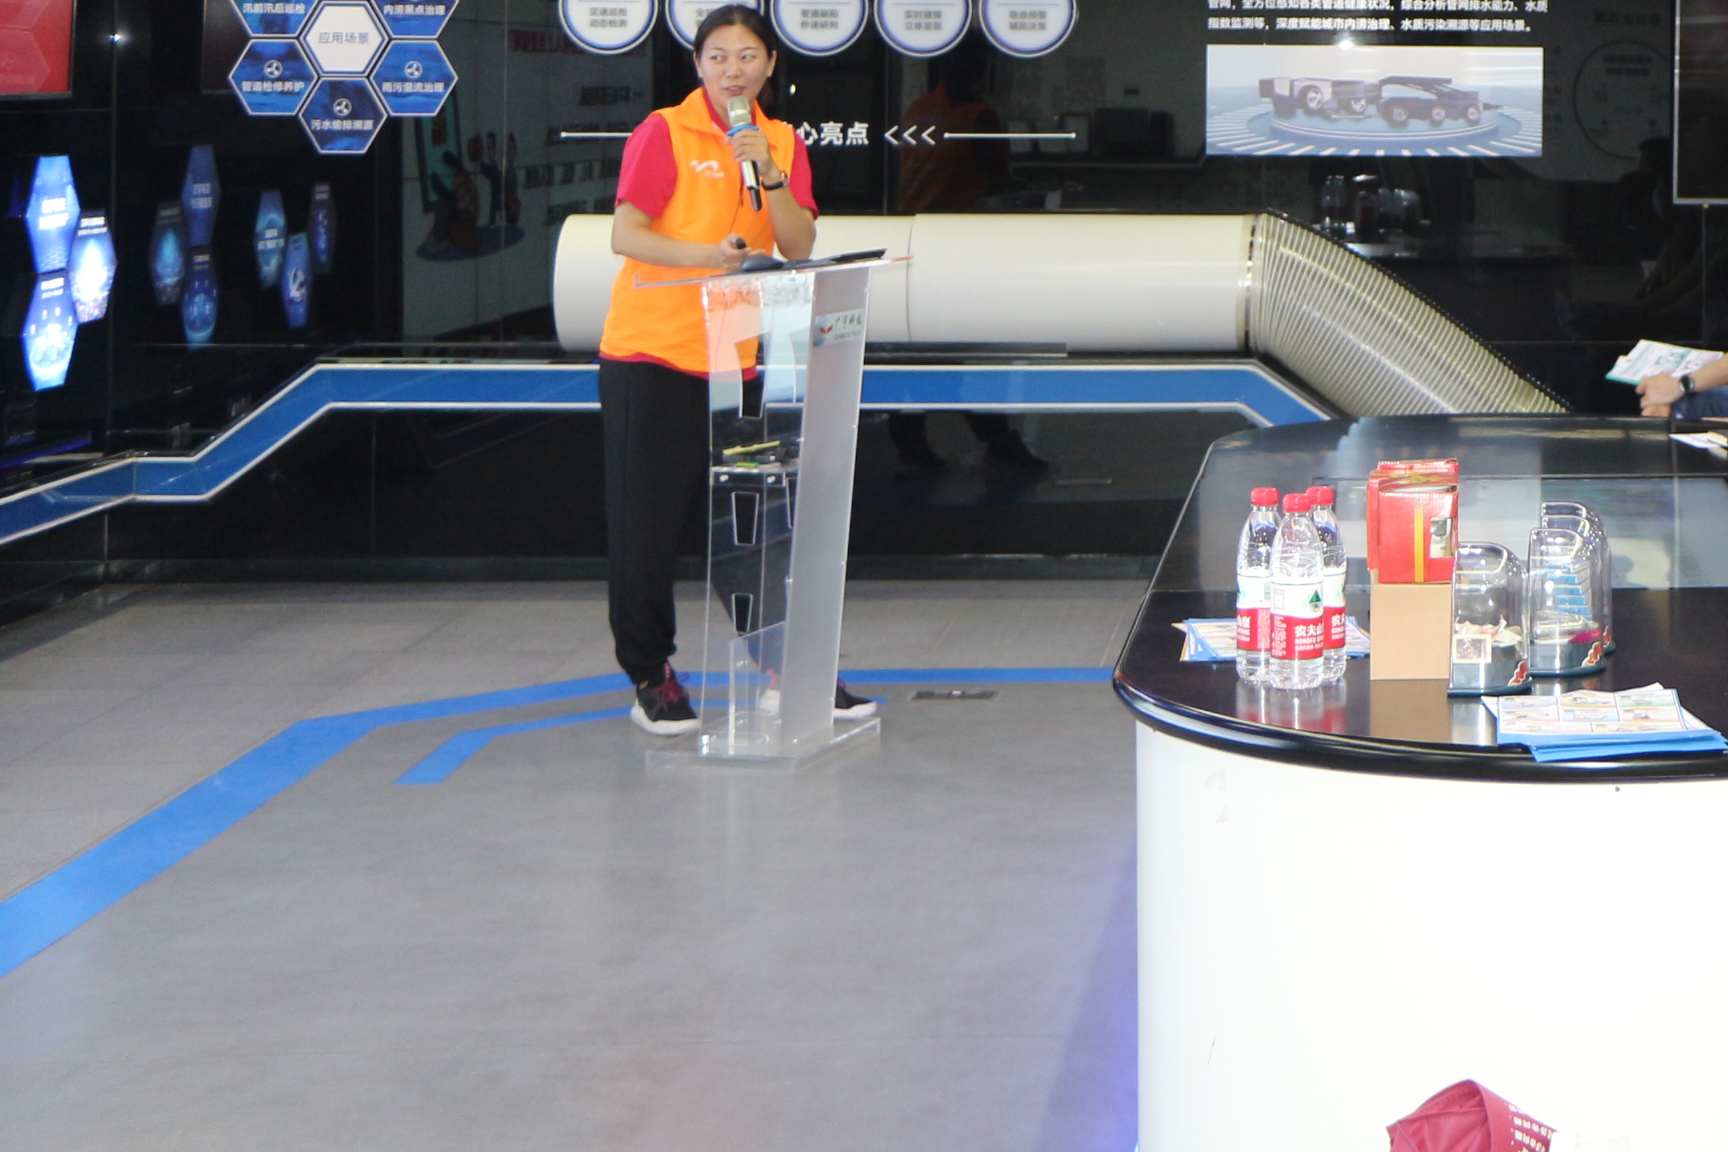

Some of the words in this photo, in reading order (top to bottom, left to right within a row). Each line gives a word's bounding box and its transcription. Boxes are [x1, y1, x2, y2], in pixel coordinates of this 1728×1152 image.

[318, 31, 370, 44] 应用场景
[786, 121, 869, 146] 心亮点
